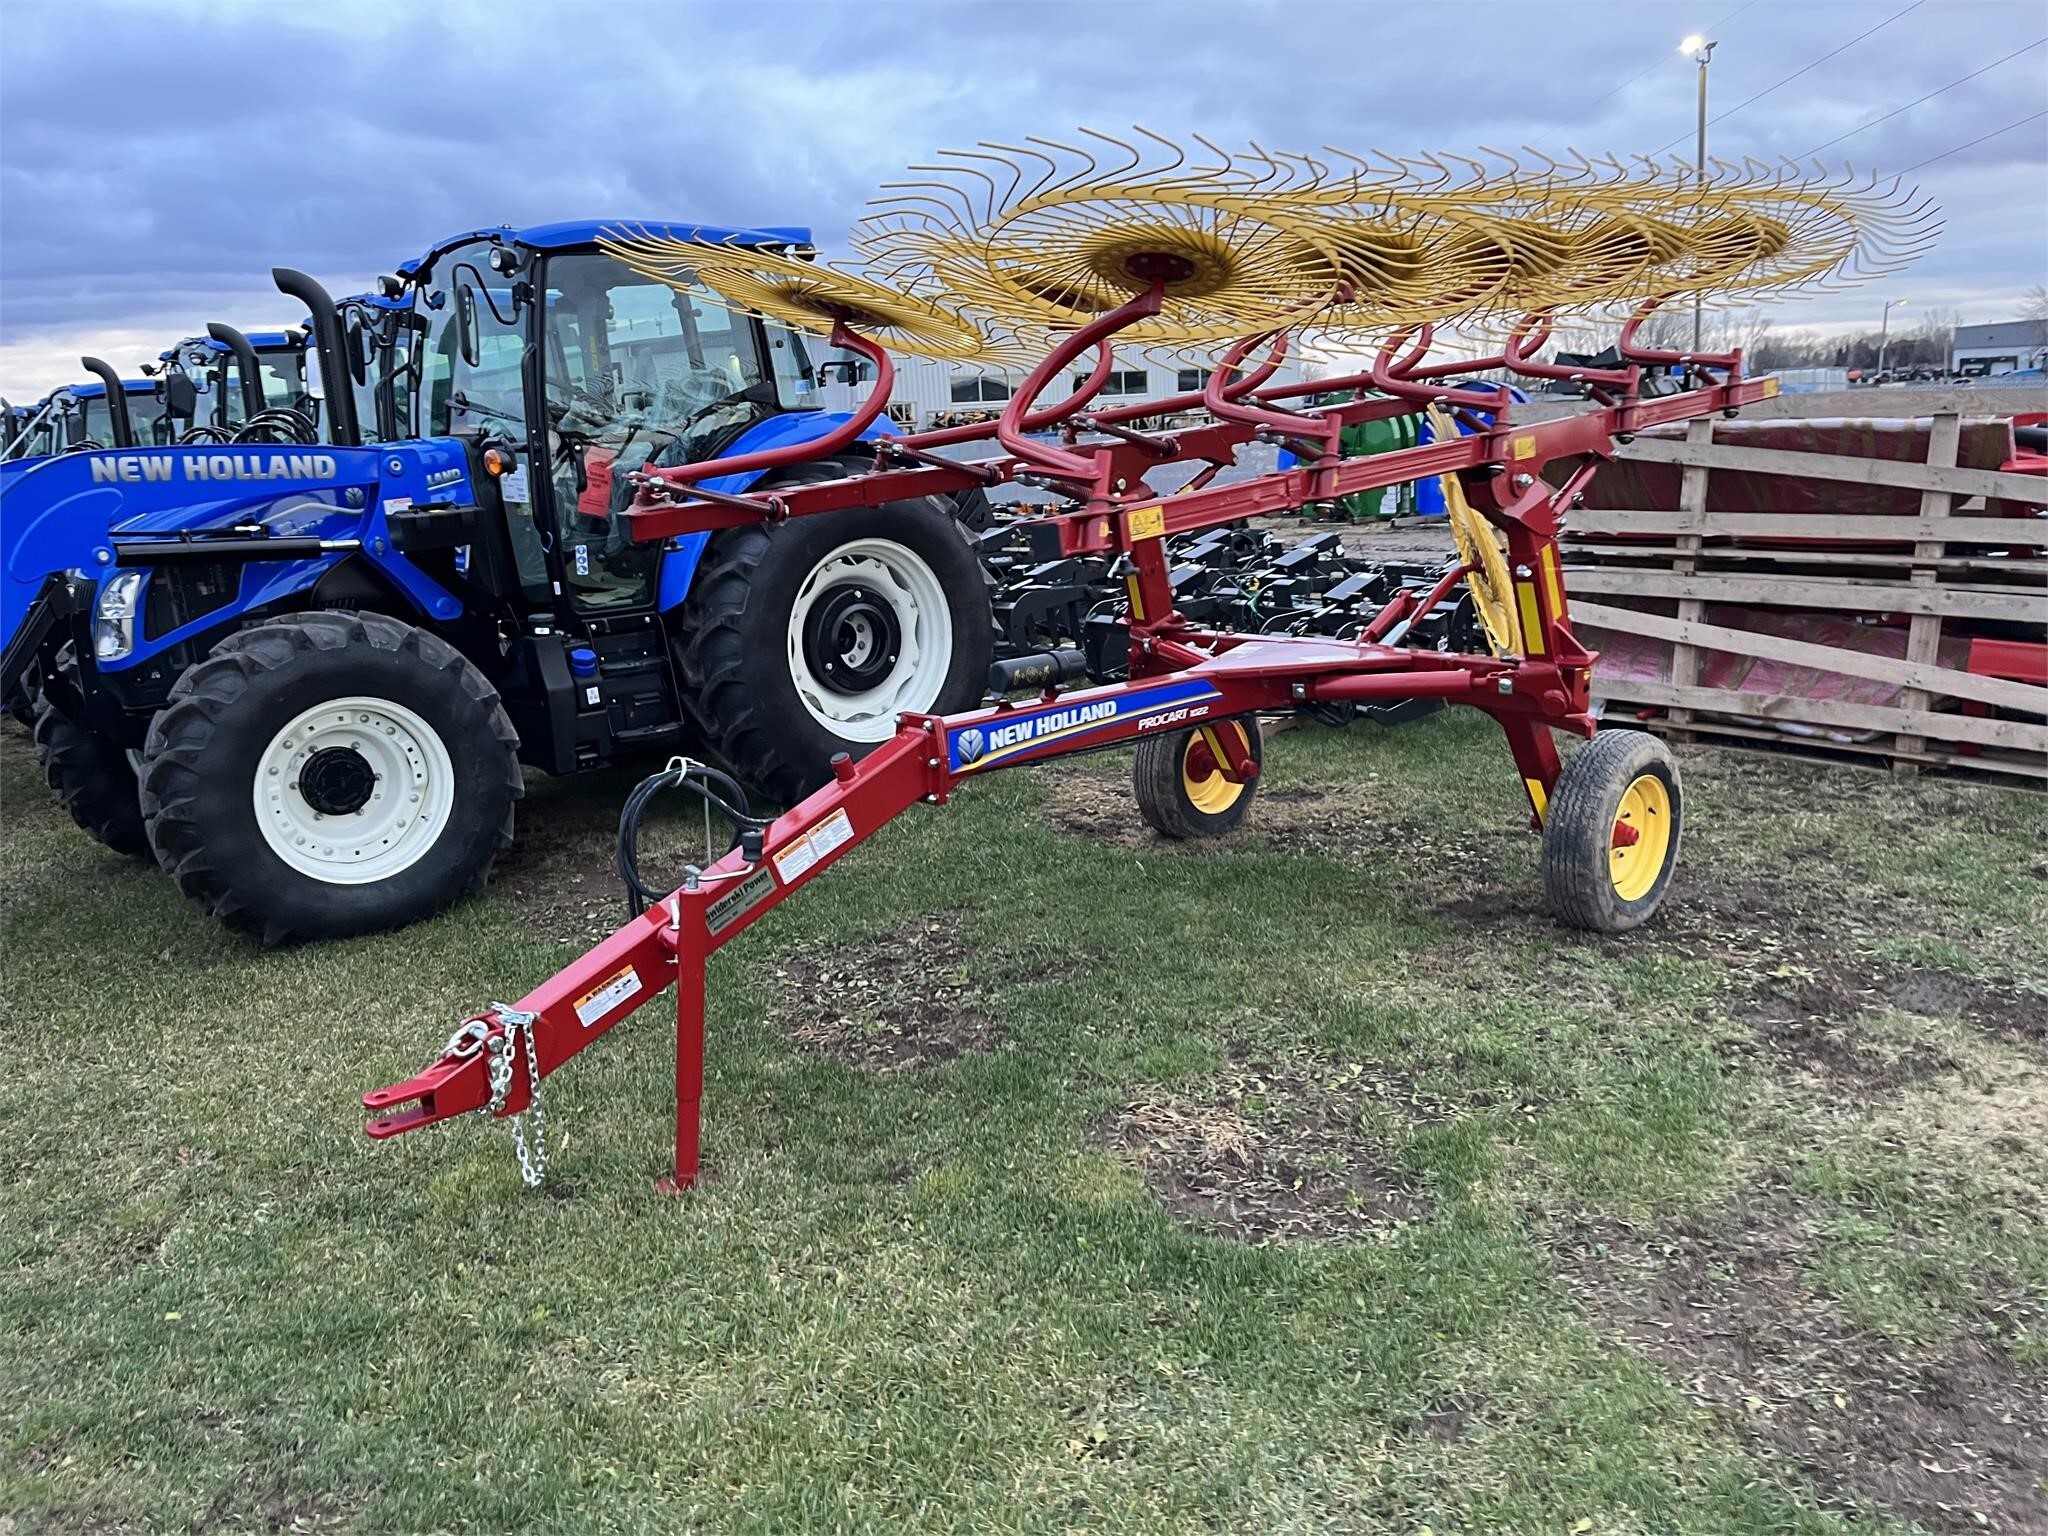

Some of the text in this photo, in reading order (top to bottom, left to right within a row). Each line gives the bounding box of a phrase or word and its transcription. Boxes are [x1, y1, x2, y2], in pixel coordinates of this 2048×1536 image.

[90, 455, 336, 482] NEW HOLLAND
[426, 468, 461, 485] LAND
[989, 700, 1117, 751] NEW HOLLAND
[1138, 708, 1189, 731] PROCART
[743, 870, 768, 892] Power
